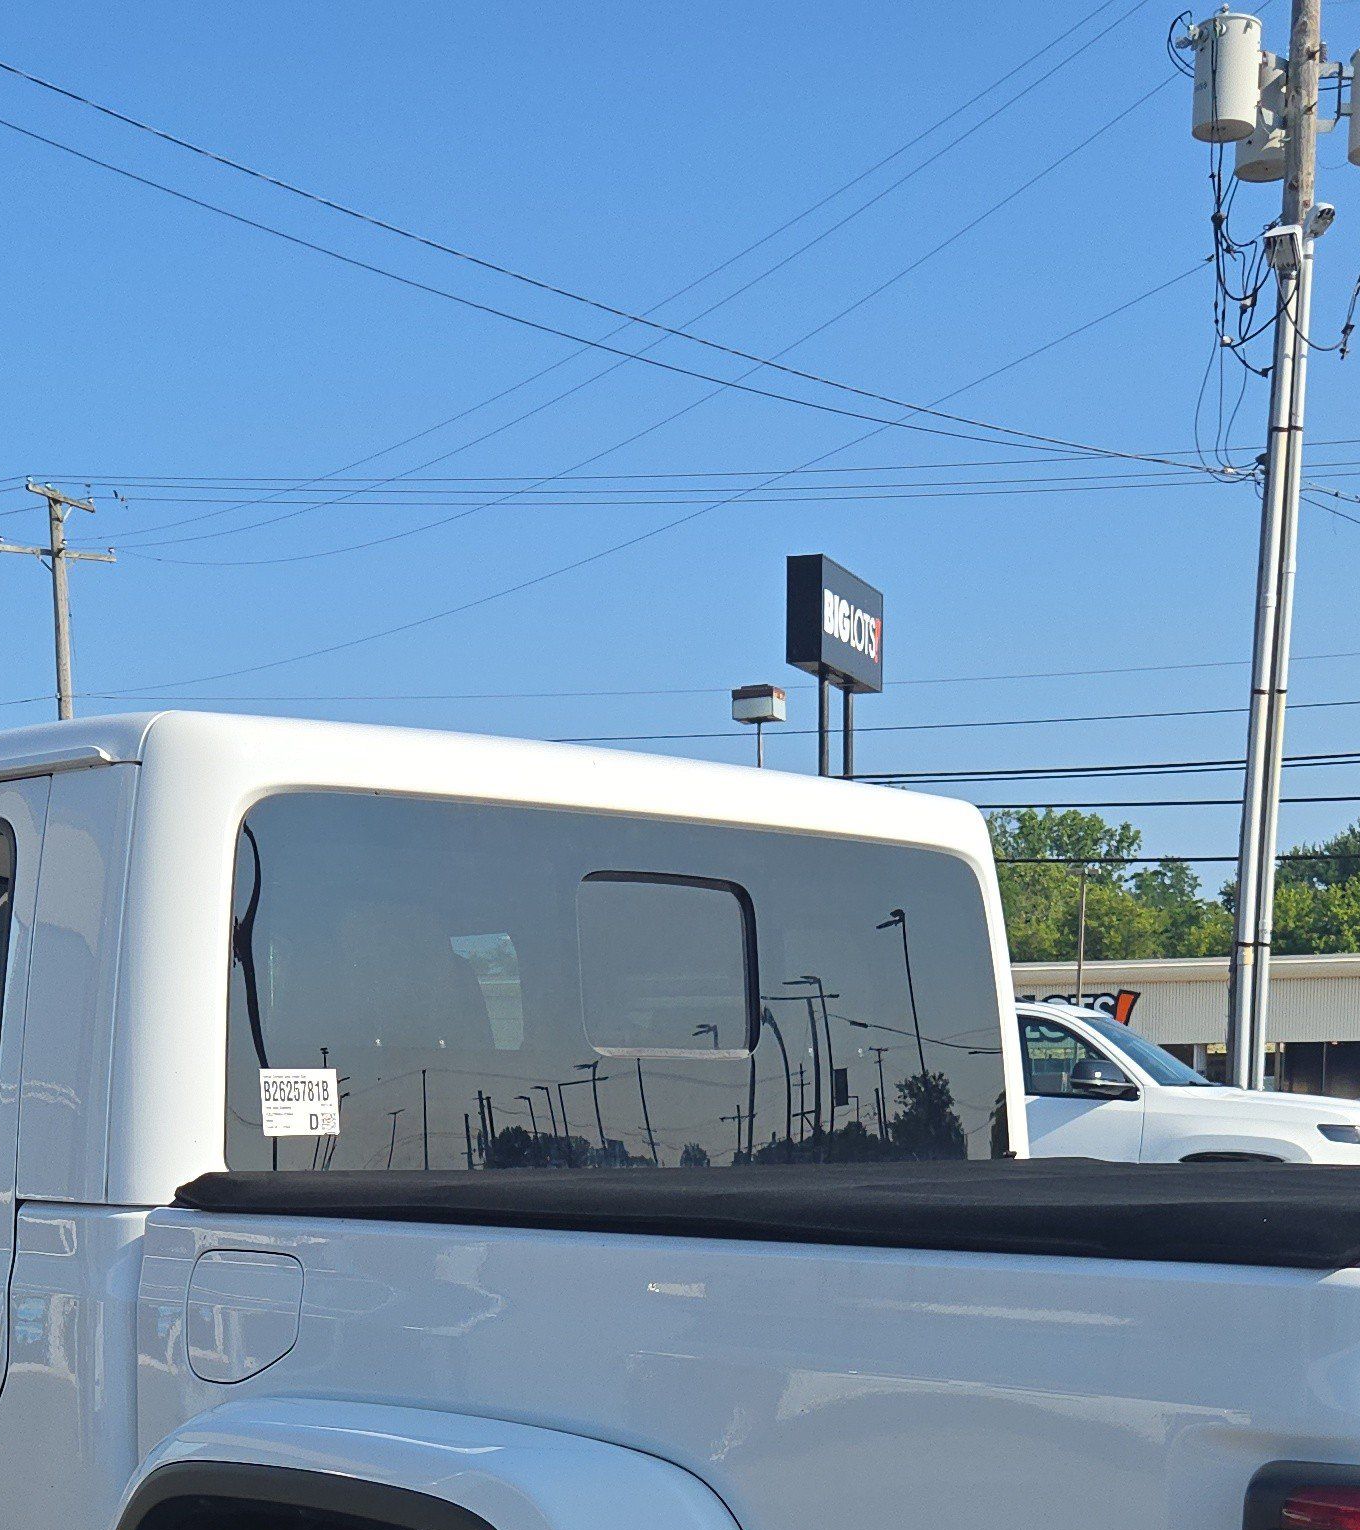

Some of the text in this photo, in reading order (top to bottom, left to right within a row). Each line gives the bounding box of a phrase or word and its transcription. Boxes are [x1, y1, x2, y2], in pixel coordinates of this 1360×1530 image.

[823, 588, 882, 664] BIG LOTS!
[263, 1080, 329, 1102] B2625781B
[309, 1113, 319, 1130] D
